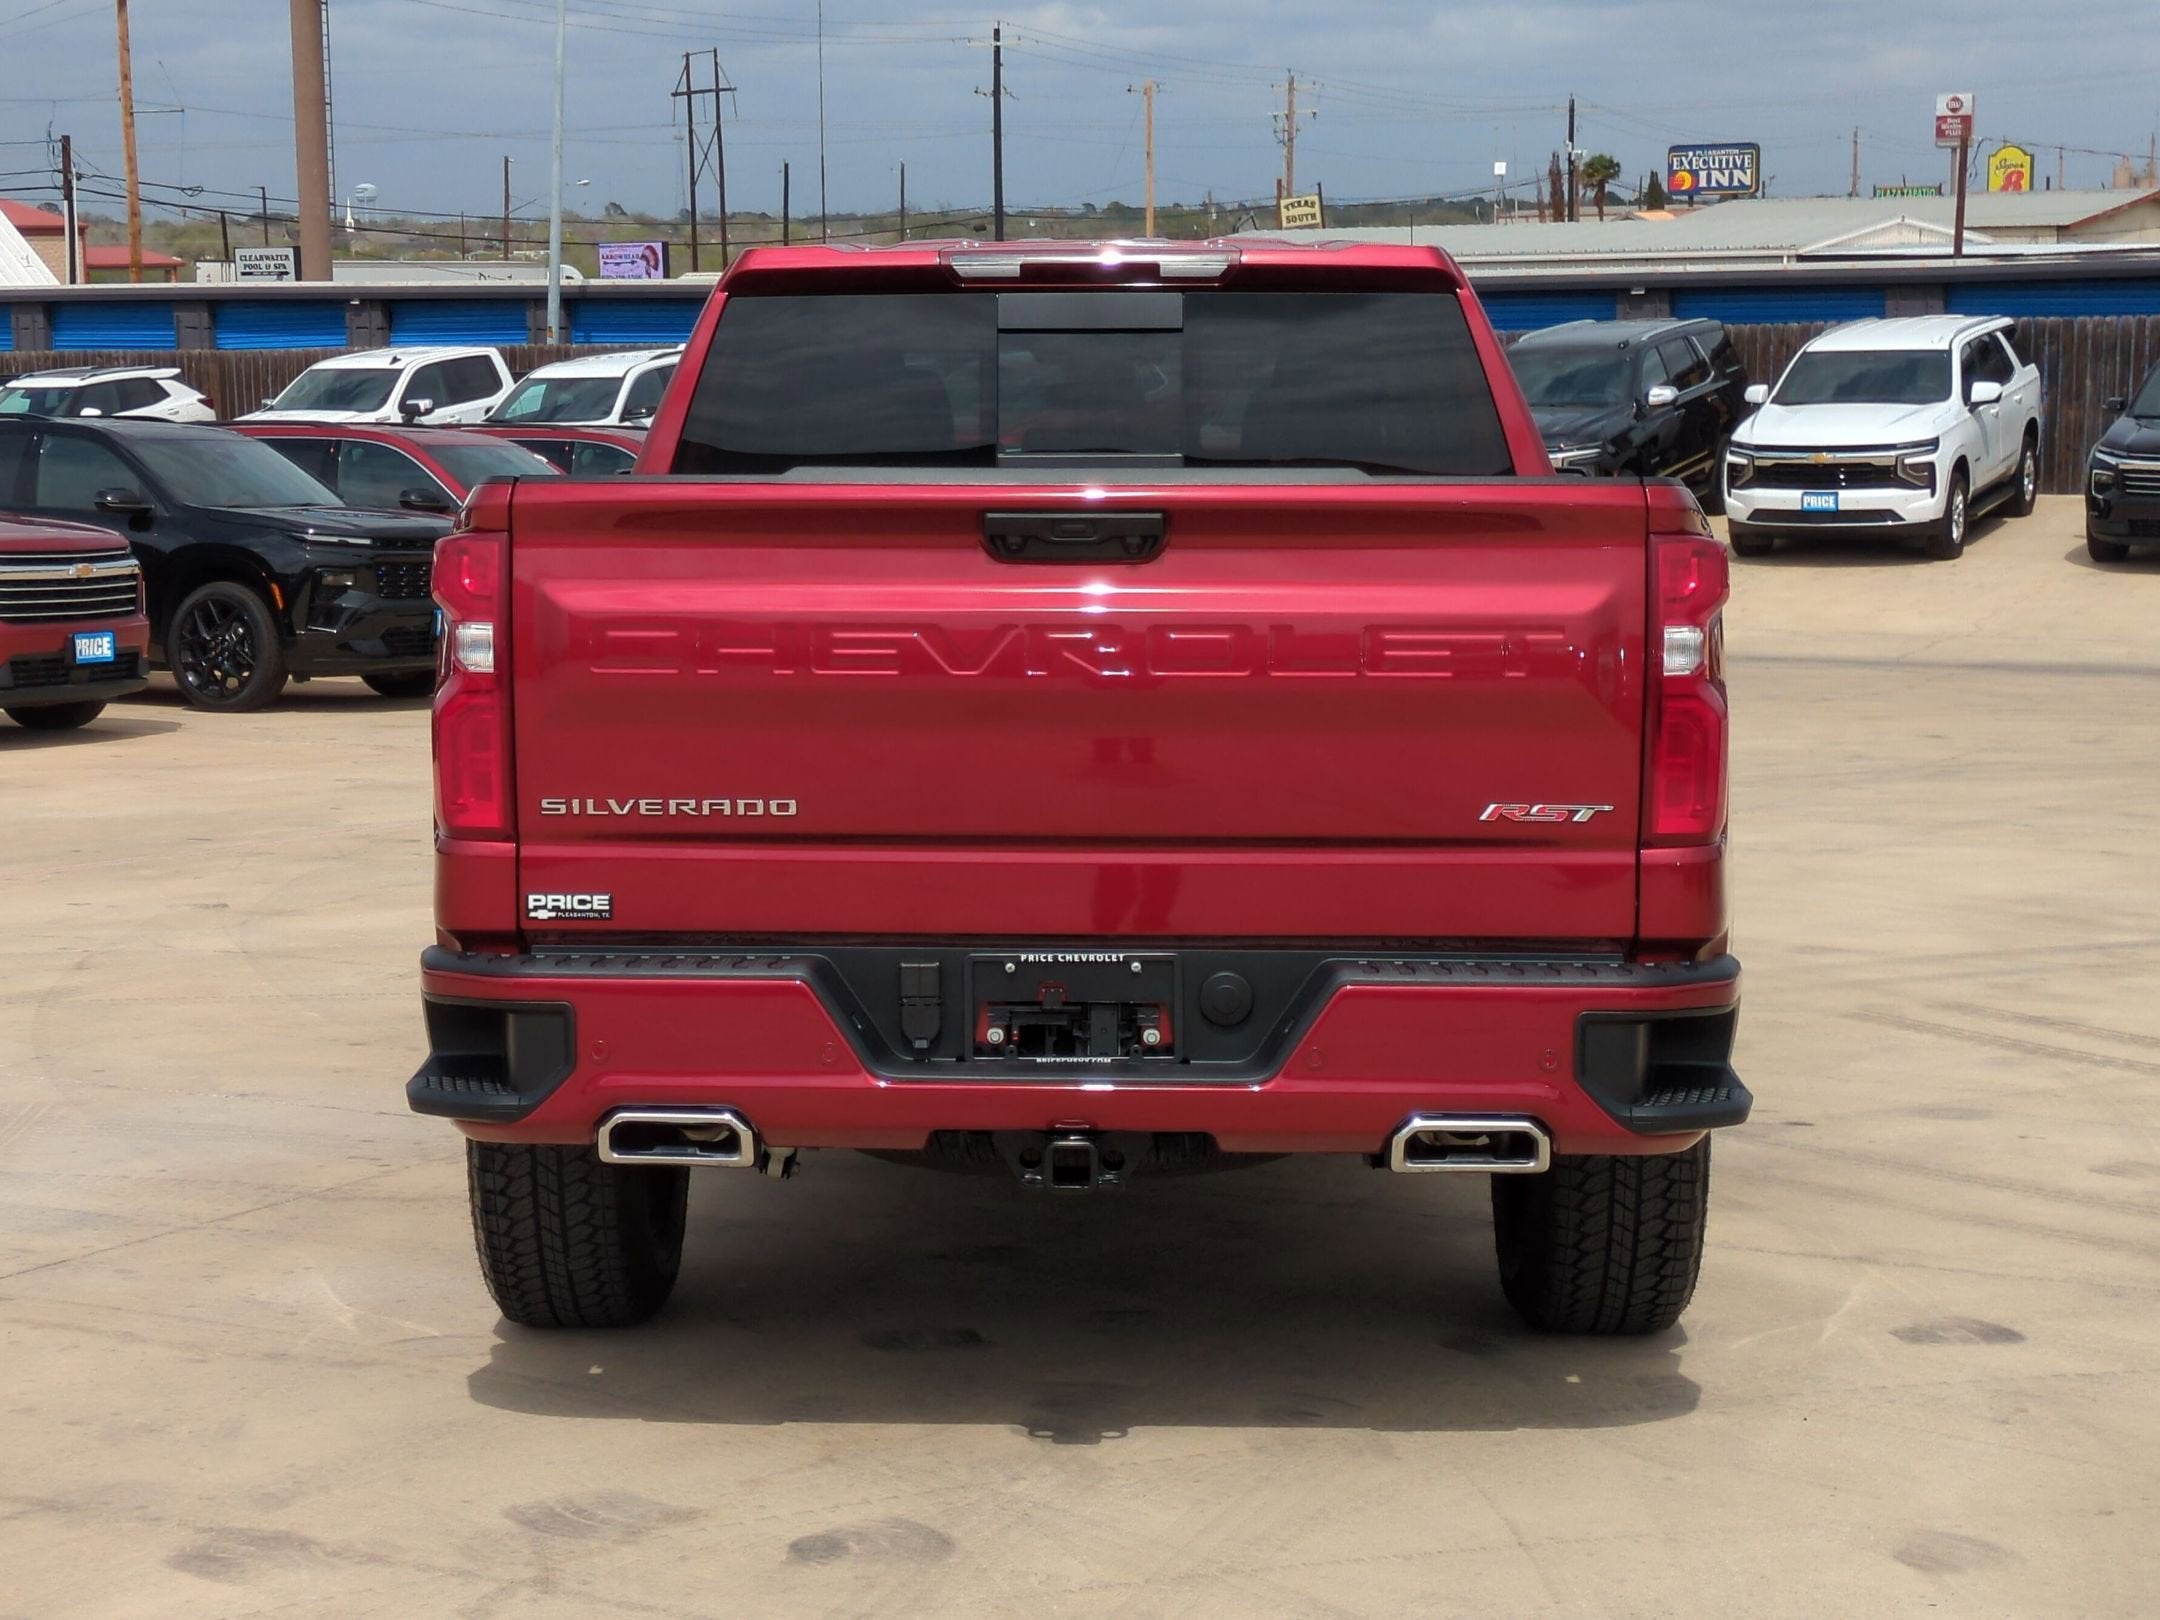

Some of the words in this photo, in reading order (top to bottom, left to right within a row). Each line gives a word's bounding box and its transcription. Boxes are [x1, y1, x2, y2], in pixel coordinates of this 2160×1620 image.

[1672, 152, 1752, 170] EXECUTIVE
[1698, 169, 1752, 187] INN
[1283, 200, 1317, 211] TEXAS
[1285, 213, 1318, 224] SOUTH
[239, 254, 290, 262] CLEARWATER
[1803, 495, 1836, 508] PRICE
[75, 637, 112, 657] PRICE
[588, 622, 1566, 677] CHEVROLET
[540, 799, 798, 816] SILVERADO
[1479, 803, 1614, 822] RST
[528, 894, 610, 910] PRICE
[1020, 954, 1054, 962] PRICE
[1057, 954, 1125, 962] CHEVROLET
